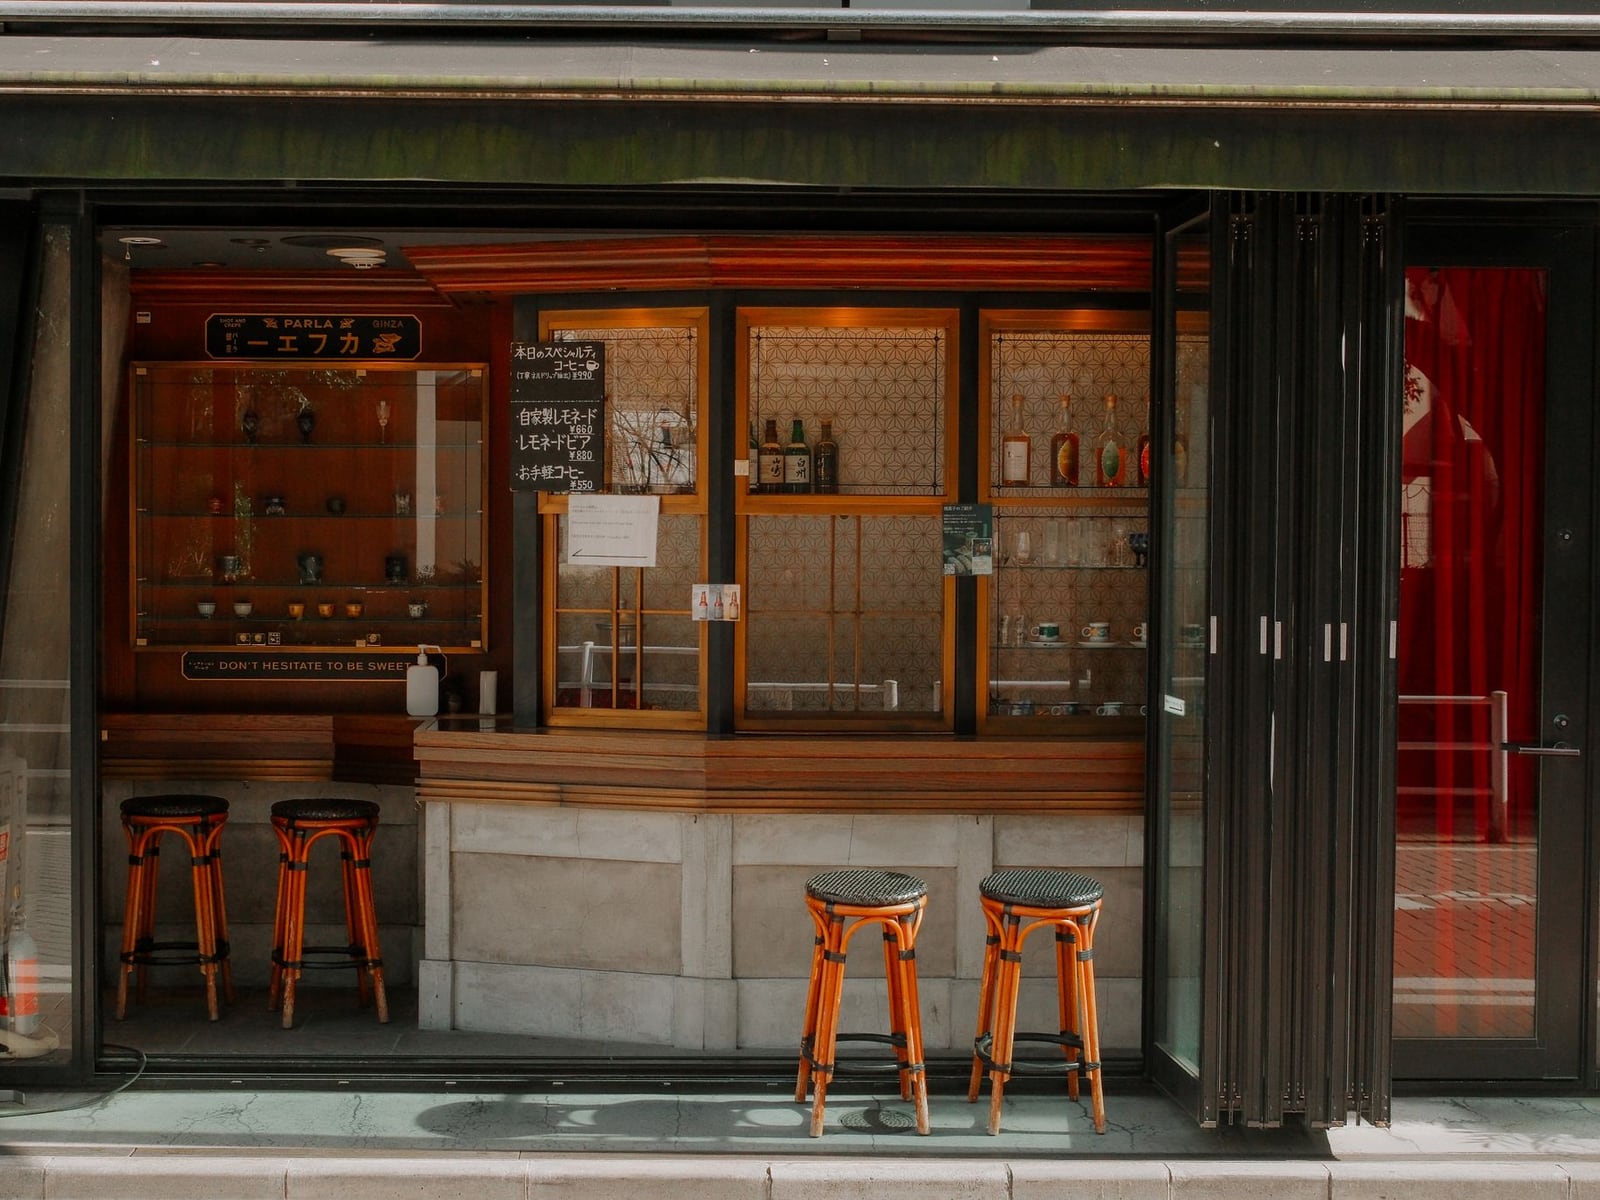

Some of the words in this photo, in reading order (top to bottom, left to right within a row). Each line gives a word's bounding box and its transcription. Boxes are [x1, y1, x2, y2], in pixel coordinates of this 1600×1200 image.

[284, 319, 334, 329] PARLA
[372, 319, 405, 329] GINZA
[514, 345, 597, 360] 本日のスペシャルティ
[554, 360, 586, 371] コーヒー
[569, 424, 593, 434] ¥660
[519, 433, 591, 451] レモネードビア
[569, 450, 593, 460] ¥880
[569, 480, 593, 490] ¥550
[219, 661, 258, 671] DON'T
[263, 661, 322, 671] HESITATE
[327, 661, 344, 671] TO
[349, 661, 364, 671] BE
[368, 661, 412, 671] SWEET
